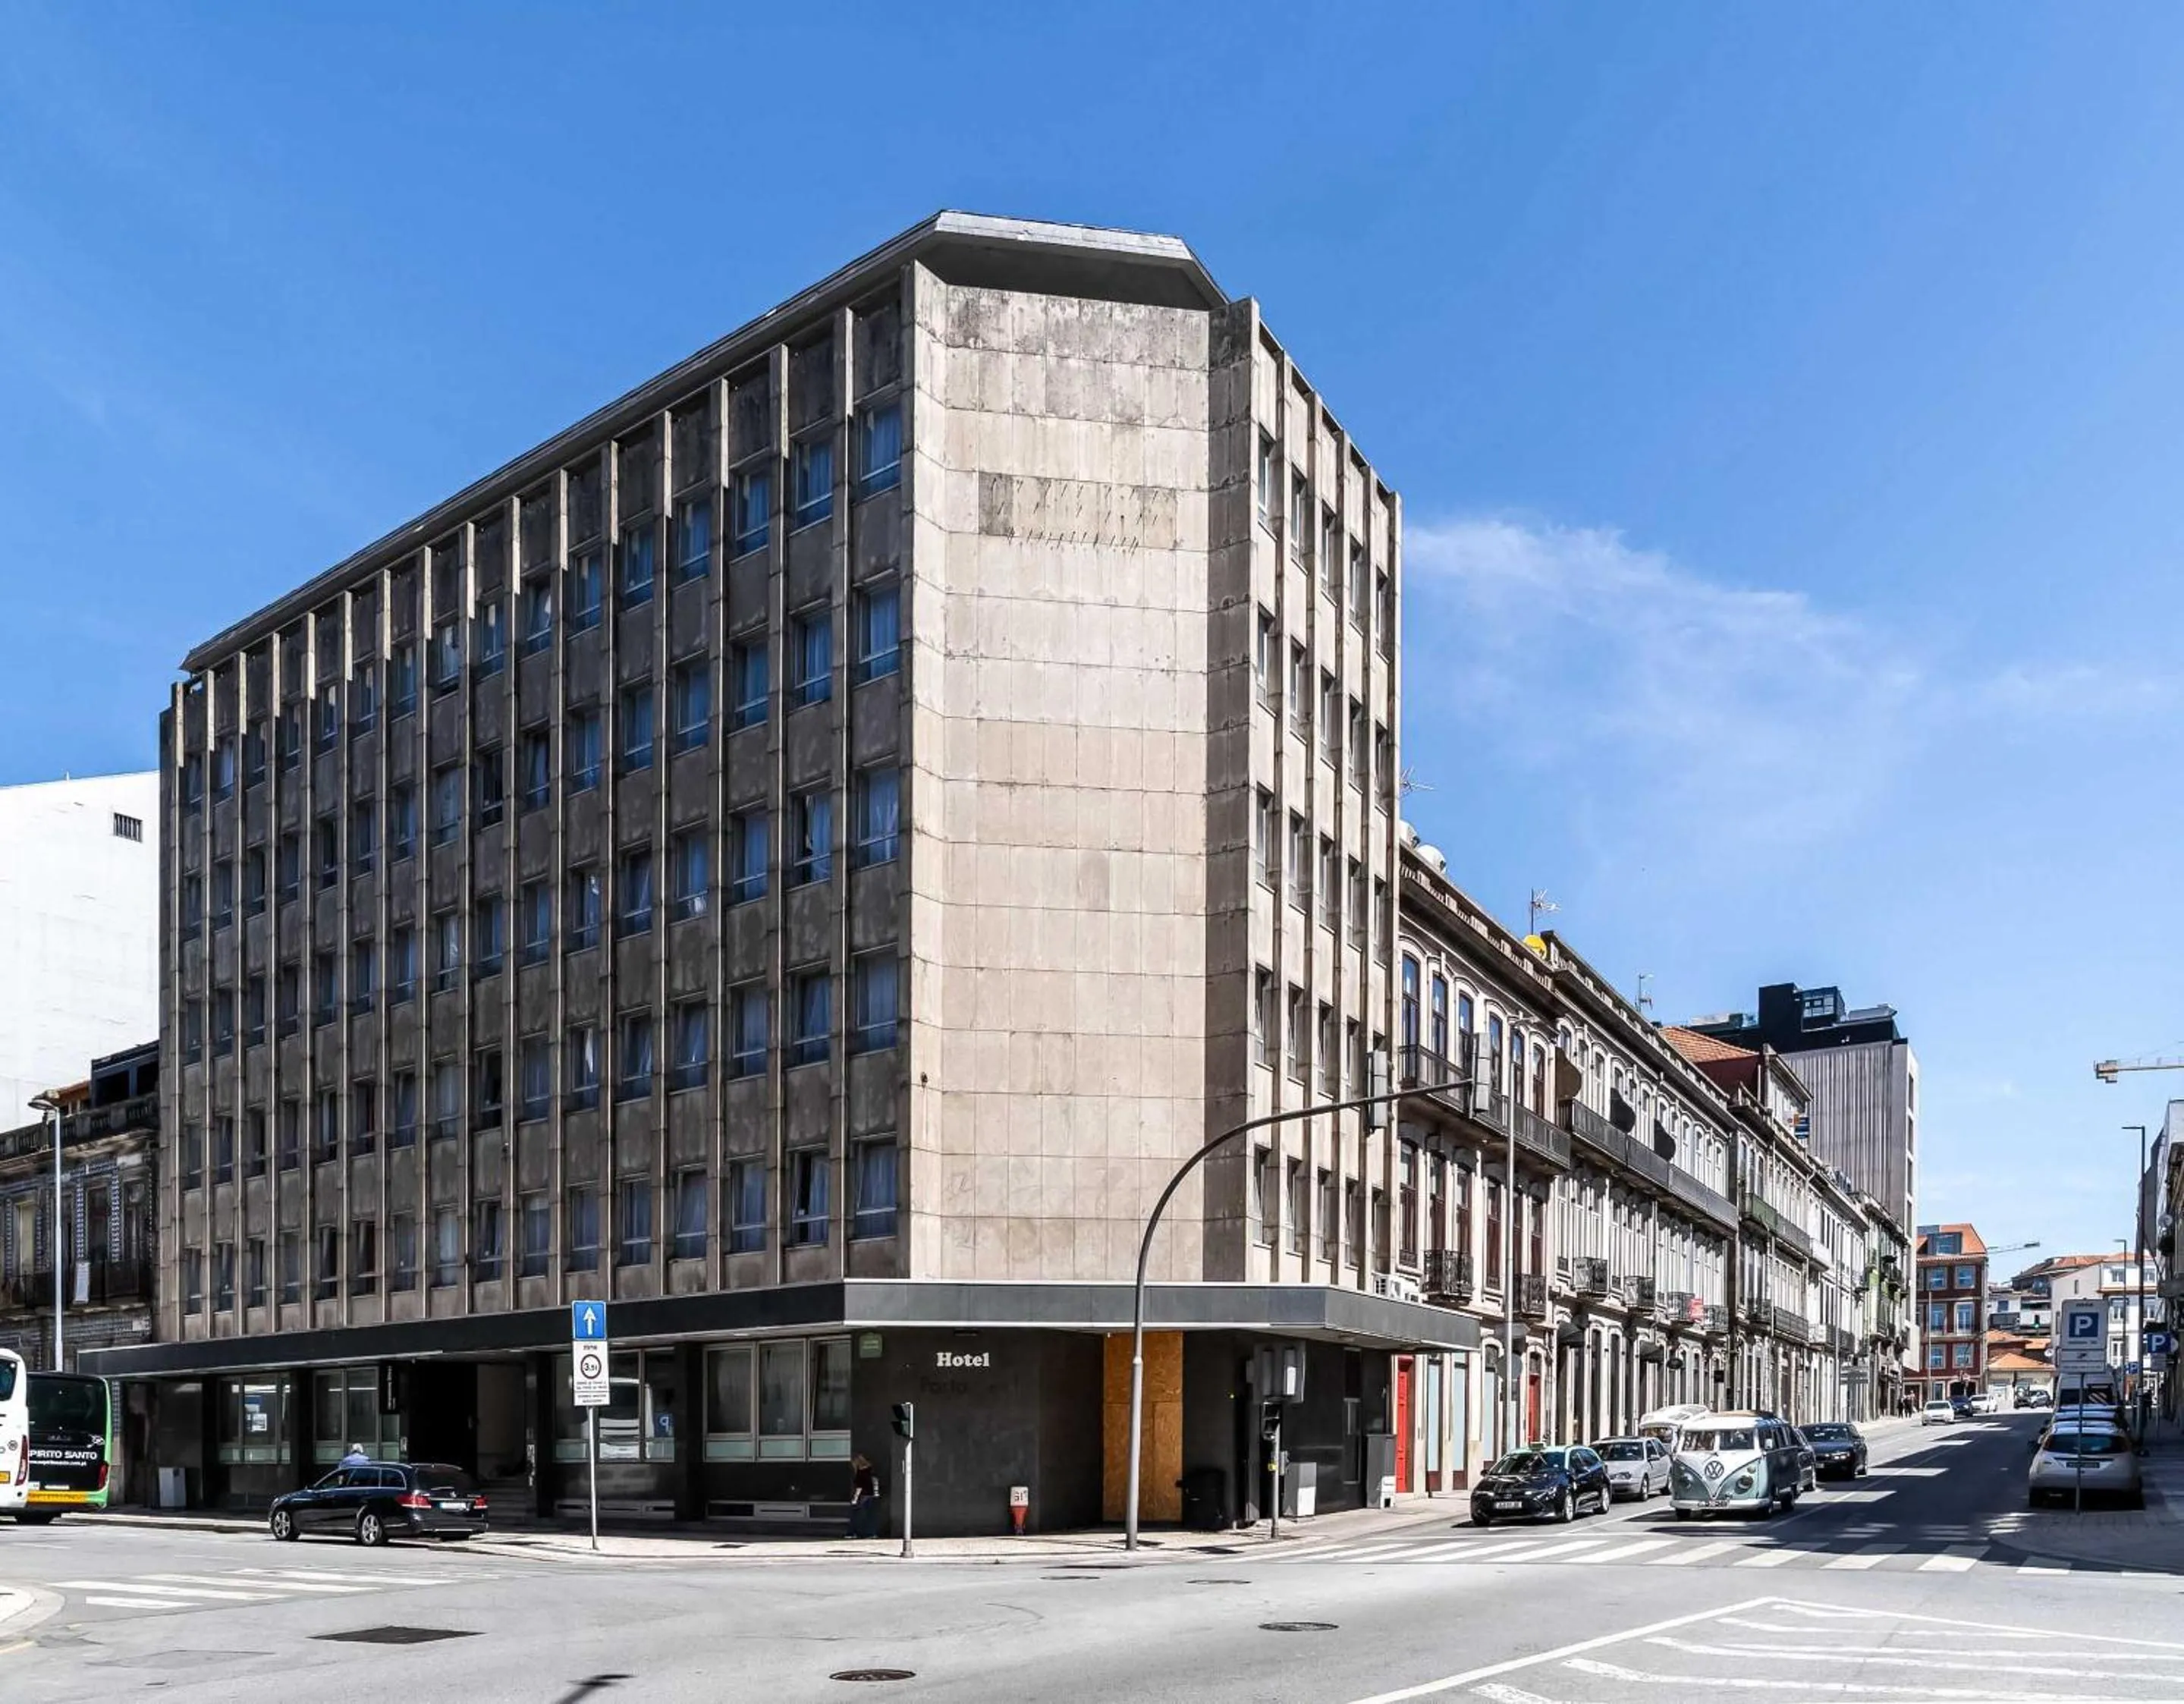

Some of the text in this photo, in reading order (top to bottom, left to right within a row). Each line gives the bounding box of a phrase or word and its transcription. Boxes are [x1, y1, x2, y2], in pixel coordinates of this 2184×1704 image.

[2075, 1316, 2092, 1335] P
[2151, 1335, 2165, 1352] P
[936, 1352, 990, 1367] Hotel
[64, 1451, 97, 1460] SANTO
